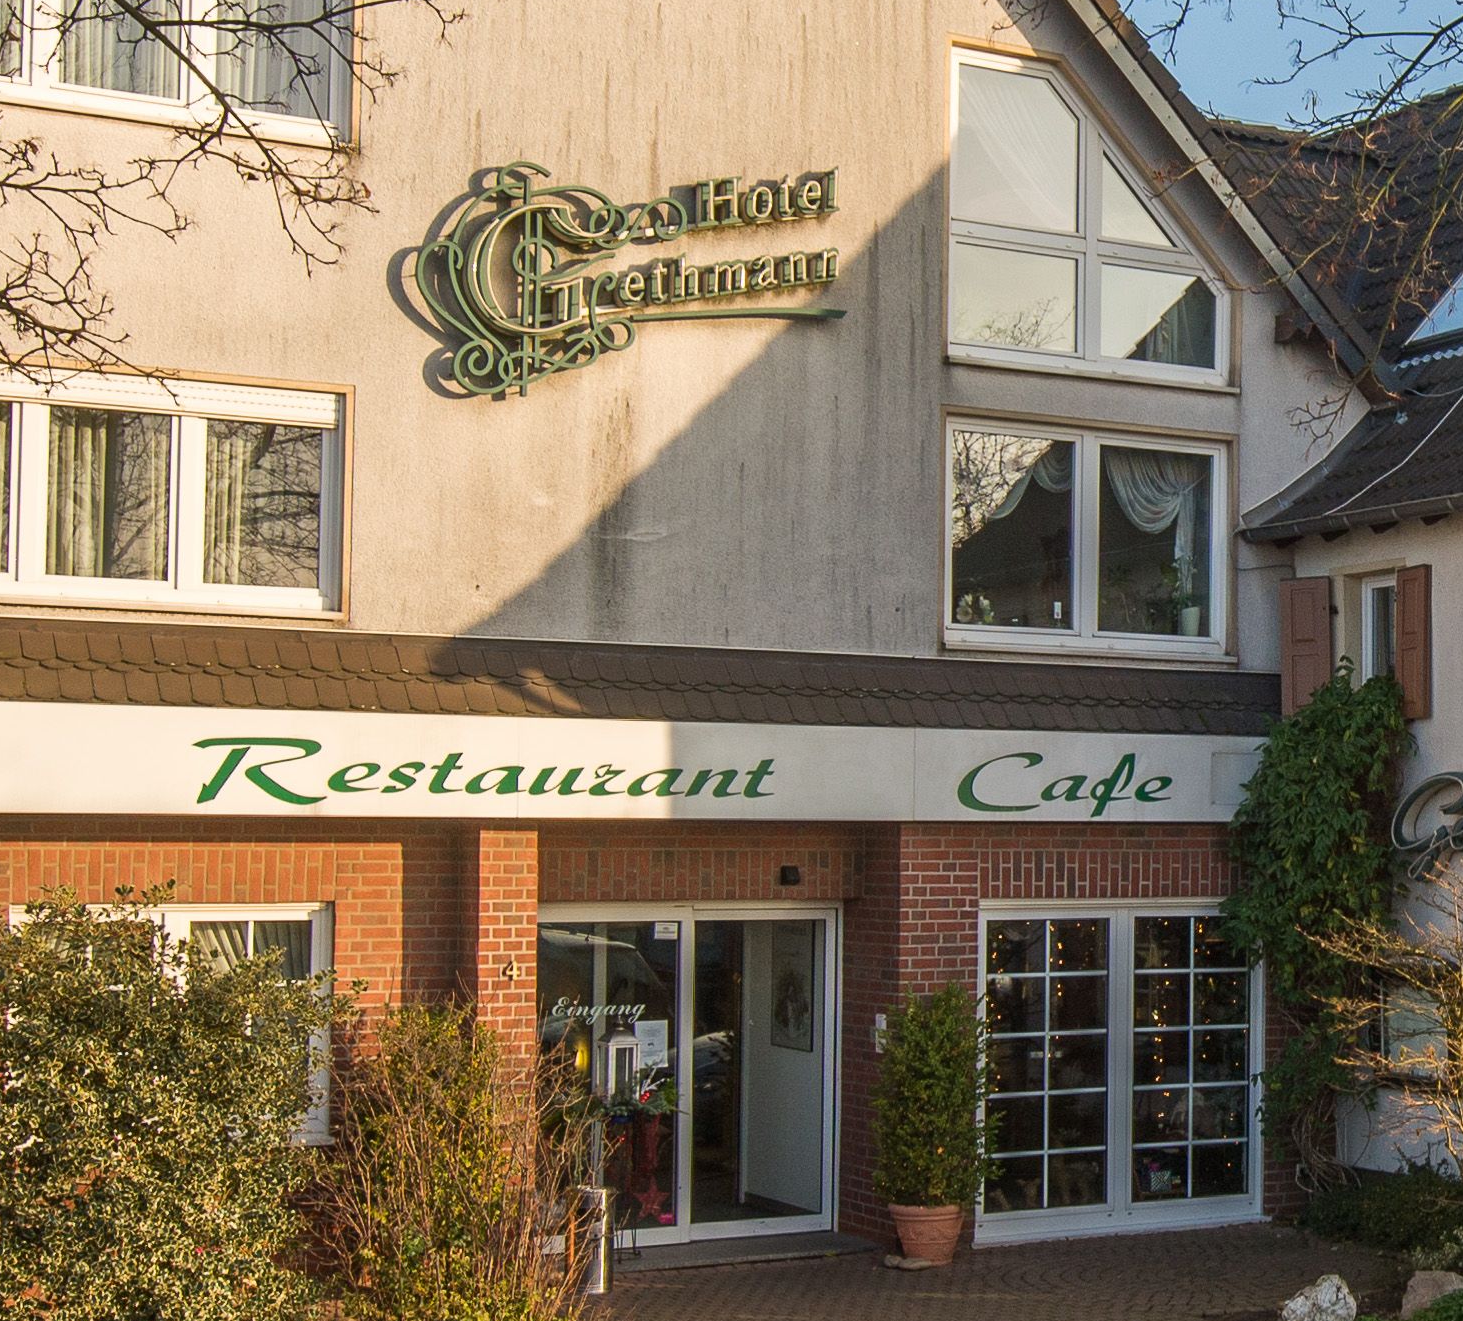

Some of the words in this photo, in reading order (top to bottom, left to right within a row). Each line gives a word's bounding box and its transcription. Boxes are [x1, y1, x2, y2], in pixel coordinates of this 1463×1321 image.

[696, 165, 840, 228] Hotel
[192, 737, 775, 805] Restaurant
[957, 752, 1173, 818] Cafe
[502, 960, 521, 981] 4
[551, 996, 646, 1026] Eingang
